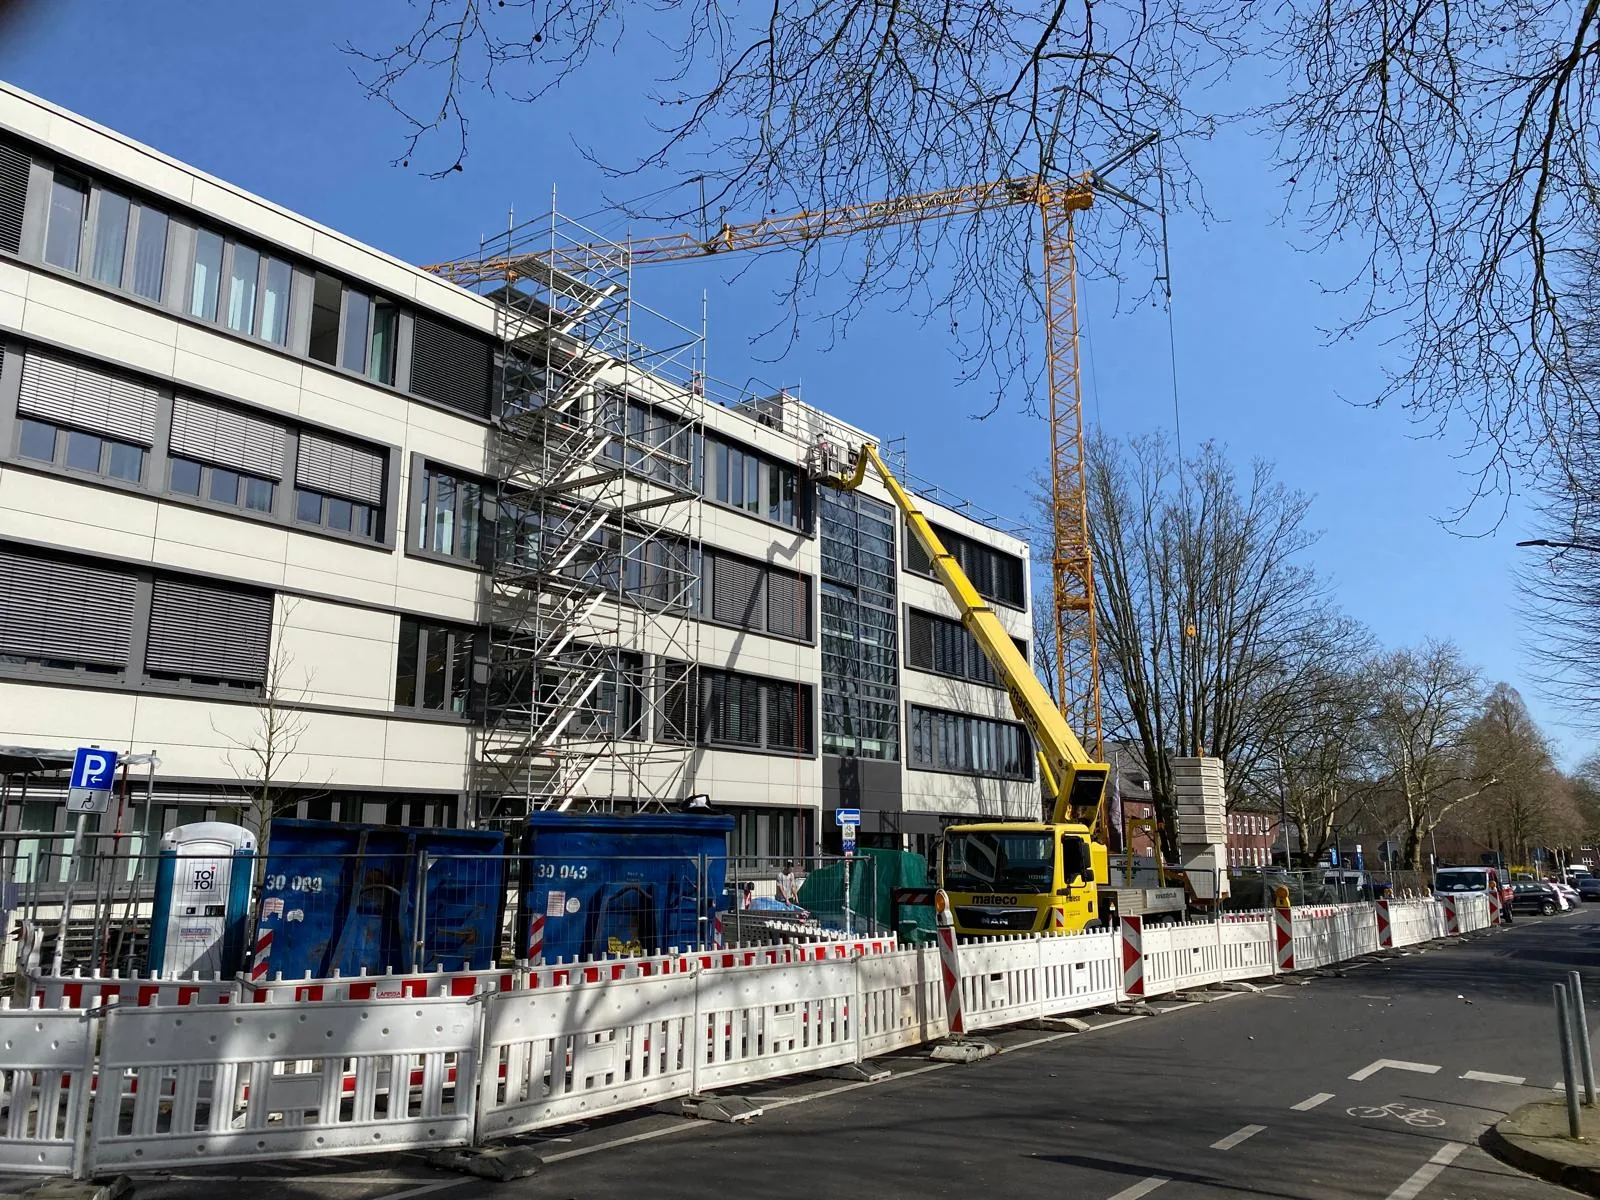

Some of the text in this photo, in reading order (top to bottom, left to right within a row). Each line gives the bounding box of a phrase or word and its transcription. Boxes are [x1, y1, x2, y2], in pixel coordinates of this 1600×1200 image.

[1010, 686, 1039, 731] mateco
[81, 754, 107, 787] P
[538, 864, 589, 880] 30 043
[193, 880, 213, 890] TOI
[266, 874, 287, 891] 30
[971, 894, 1018, 906] mateco
[981, 917, 1009, 926] MAN
